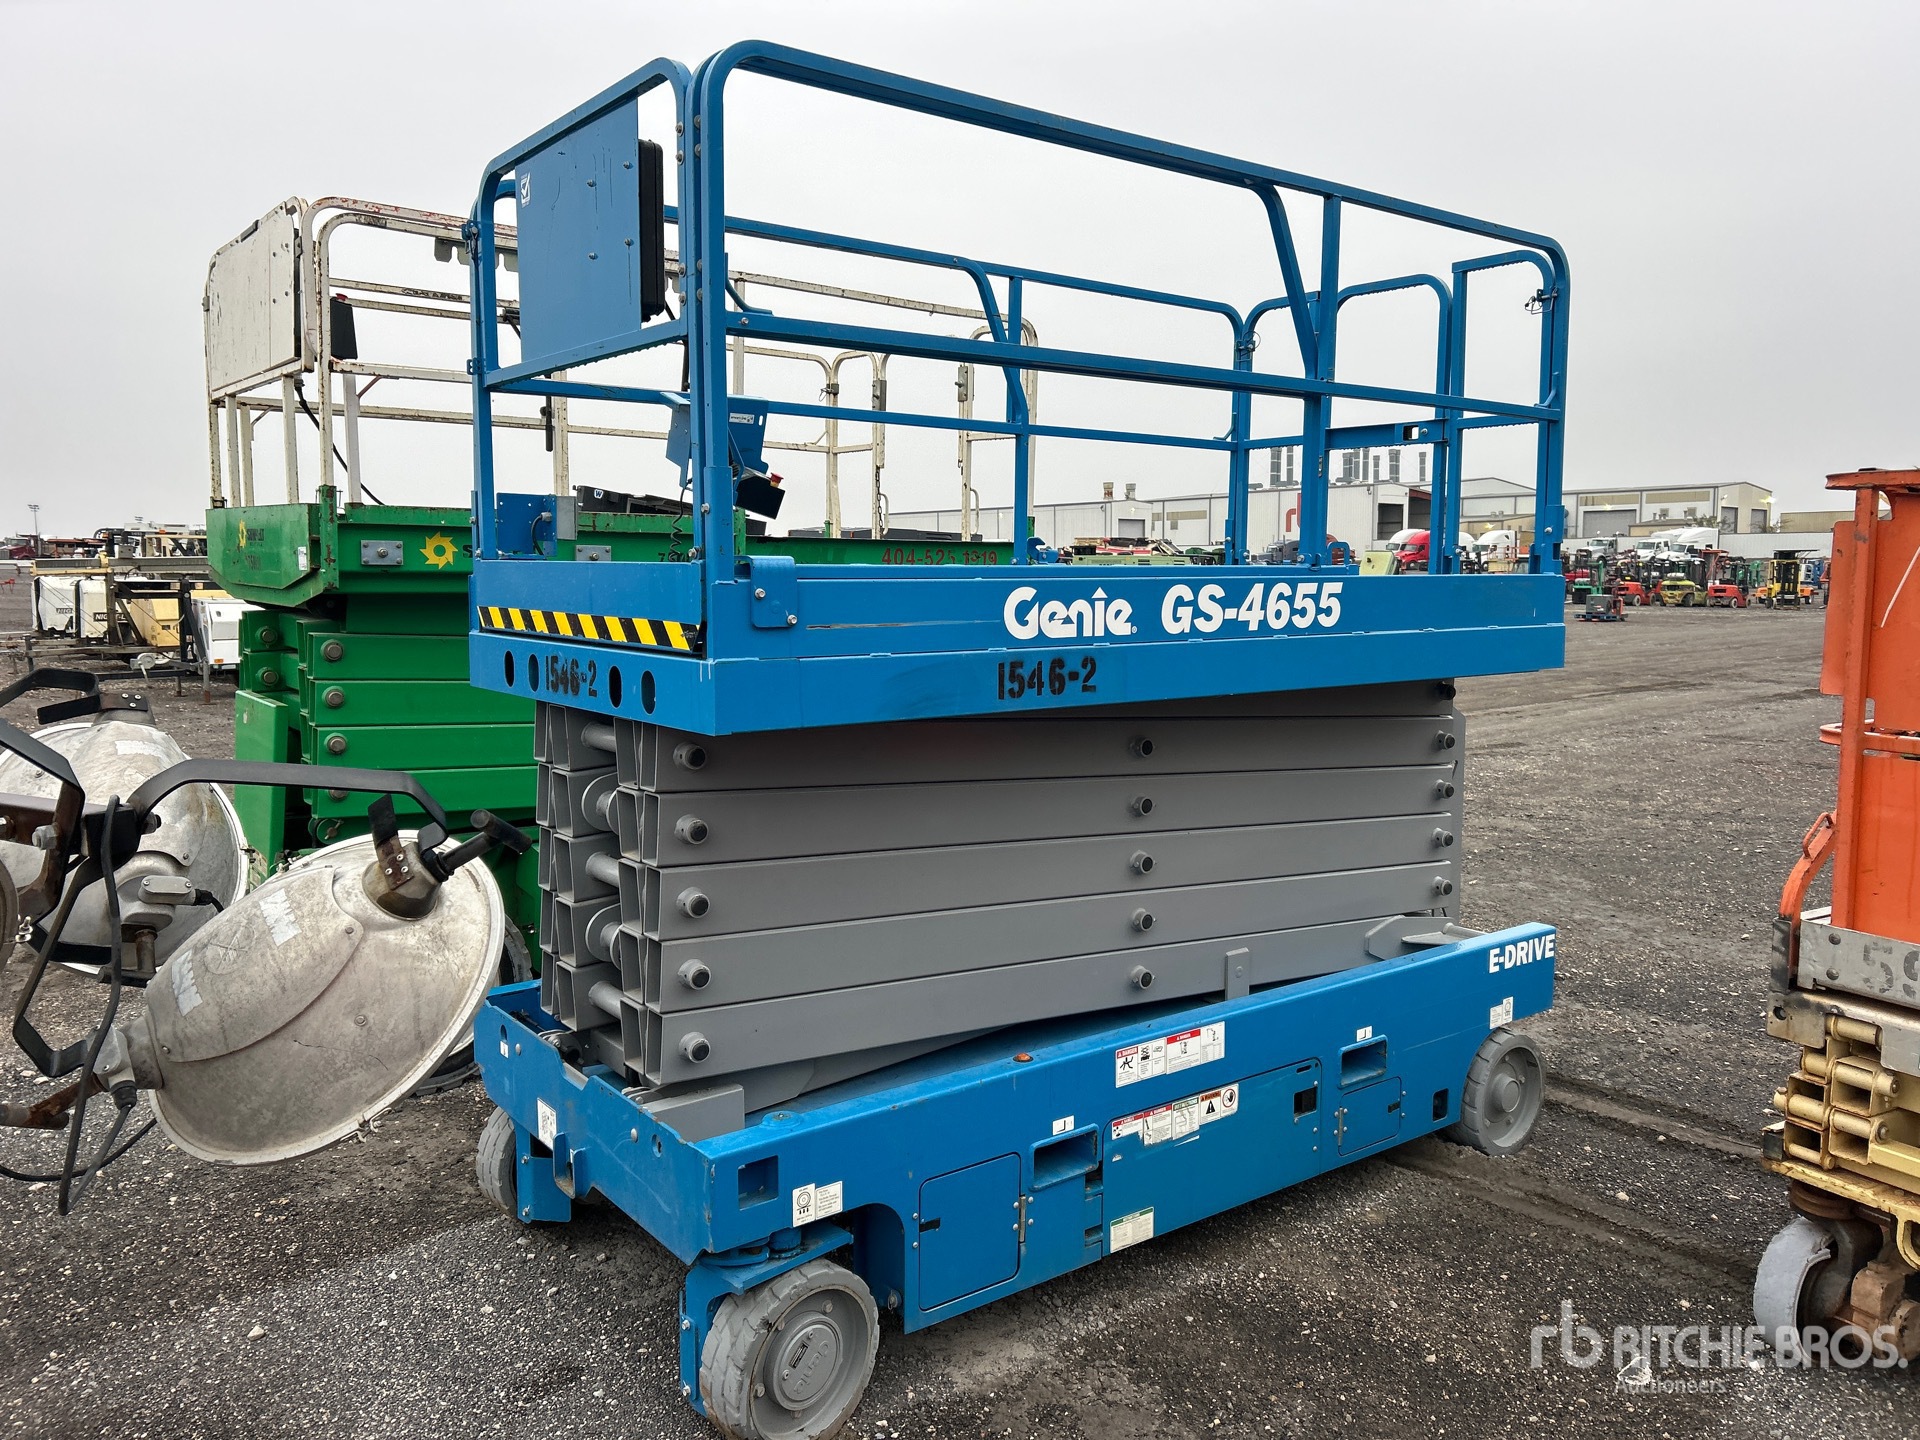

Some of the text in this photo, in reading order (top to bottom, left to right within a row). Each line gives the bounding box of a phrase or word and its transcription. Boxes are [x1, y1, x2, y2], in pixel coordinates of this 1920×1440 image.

[1004, 581, 1344, 640] Genie GS-4655
[545, 655, 598, 698] 1546-2
[997, 656, 1097, 700] 1546-2
[1489, 934, 1556, 974] E-DRIVE
